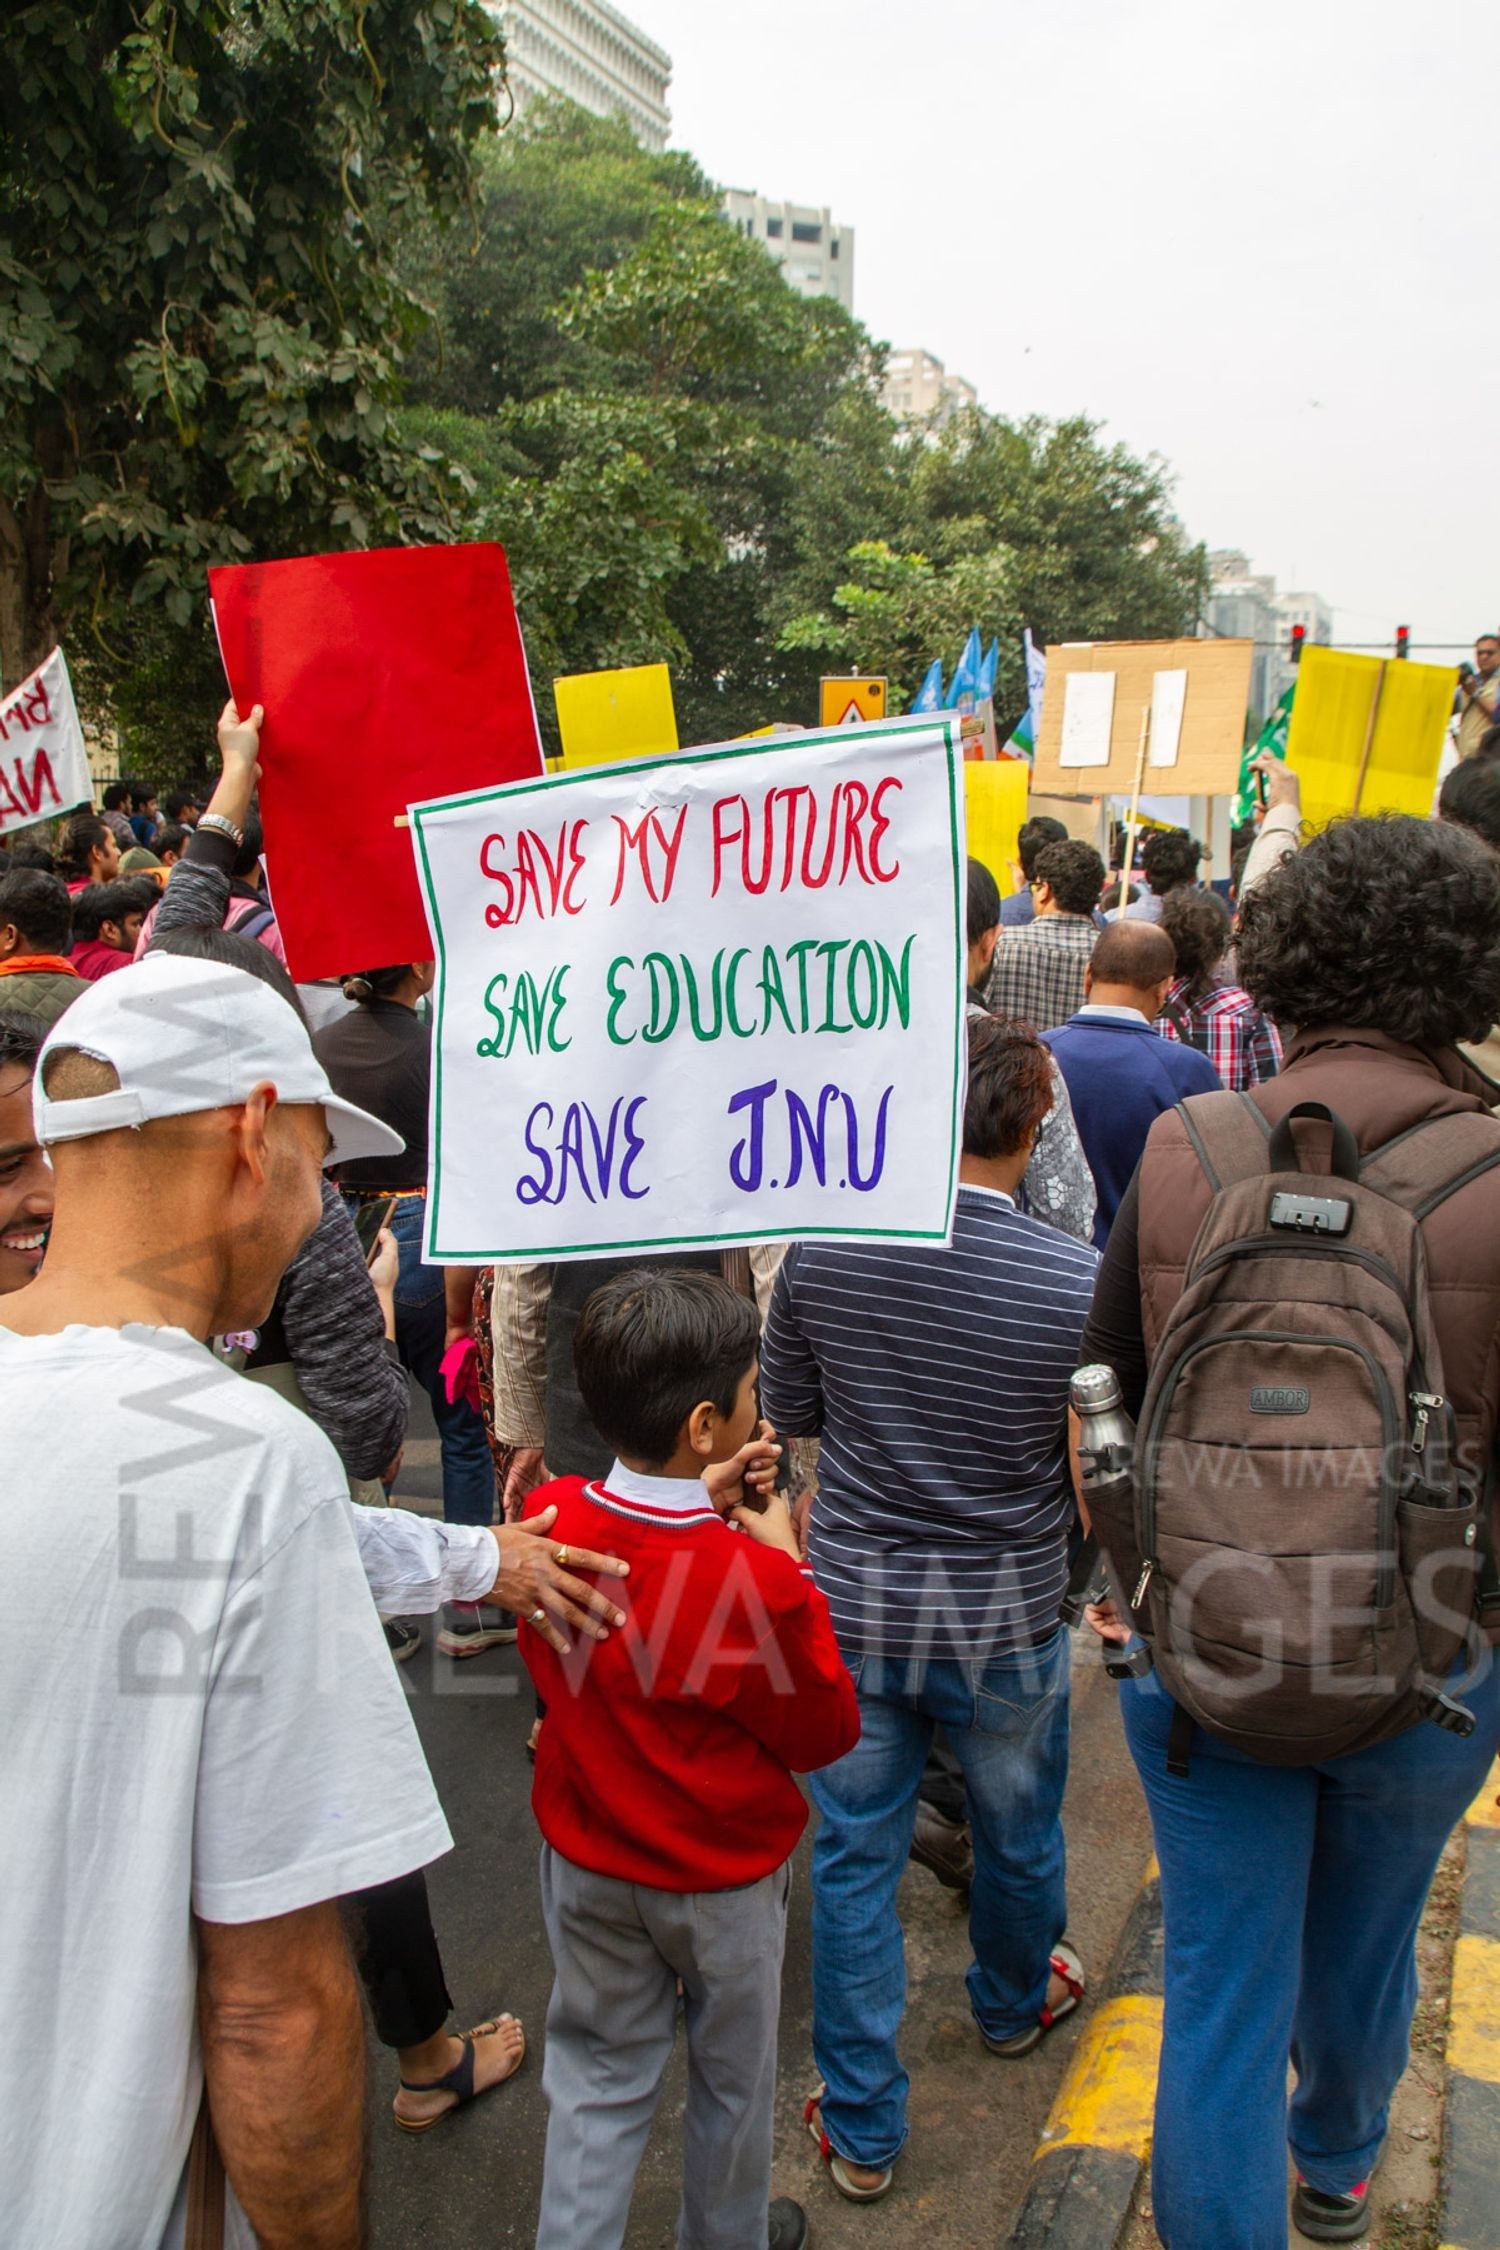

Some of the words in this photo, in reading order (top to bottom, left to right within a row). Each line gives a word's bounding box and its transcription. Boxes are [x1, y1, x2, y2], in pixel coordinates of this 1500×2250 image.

[479, 818, 590, 929] SAVE
[609, 804, 687, 906] MY
[711, 776, 902, 899] FUTURE
[476, 963, 573, 1059] SAVE
[606, 933, 918, 1046] EDUCATION
[515, 1095, 650, 1206] SAVE
[727, 1078, 895, 1193] J.N.U
